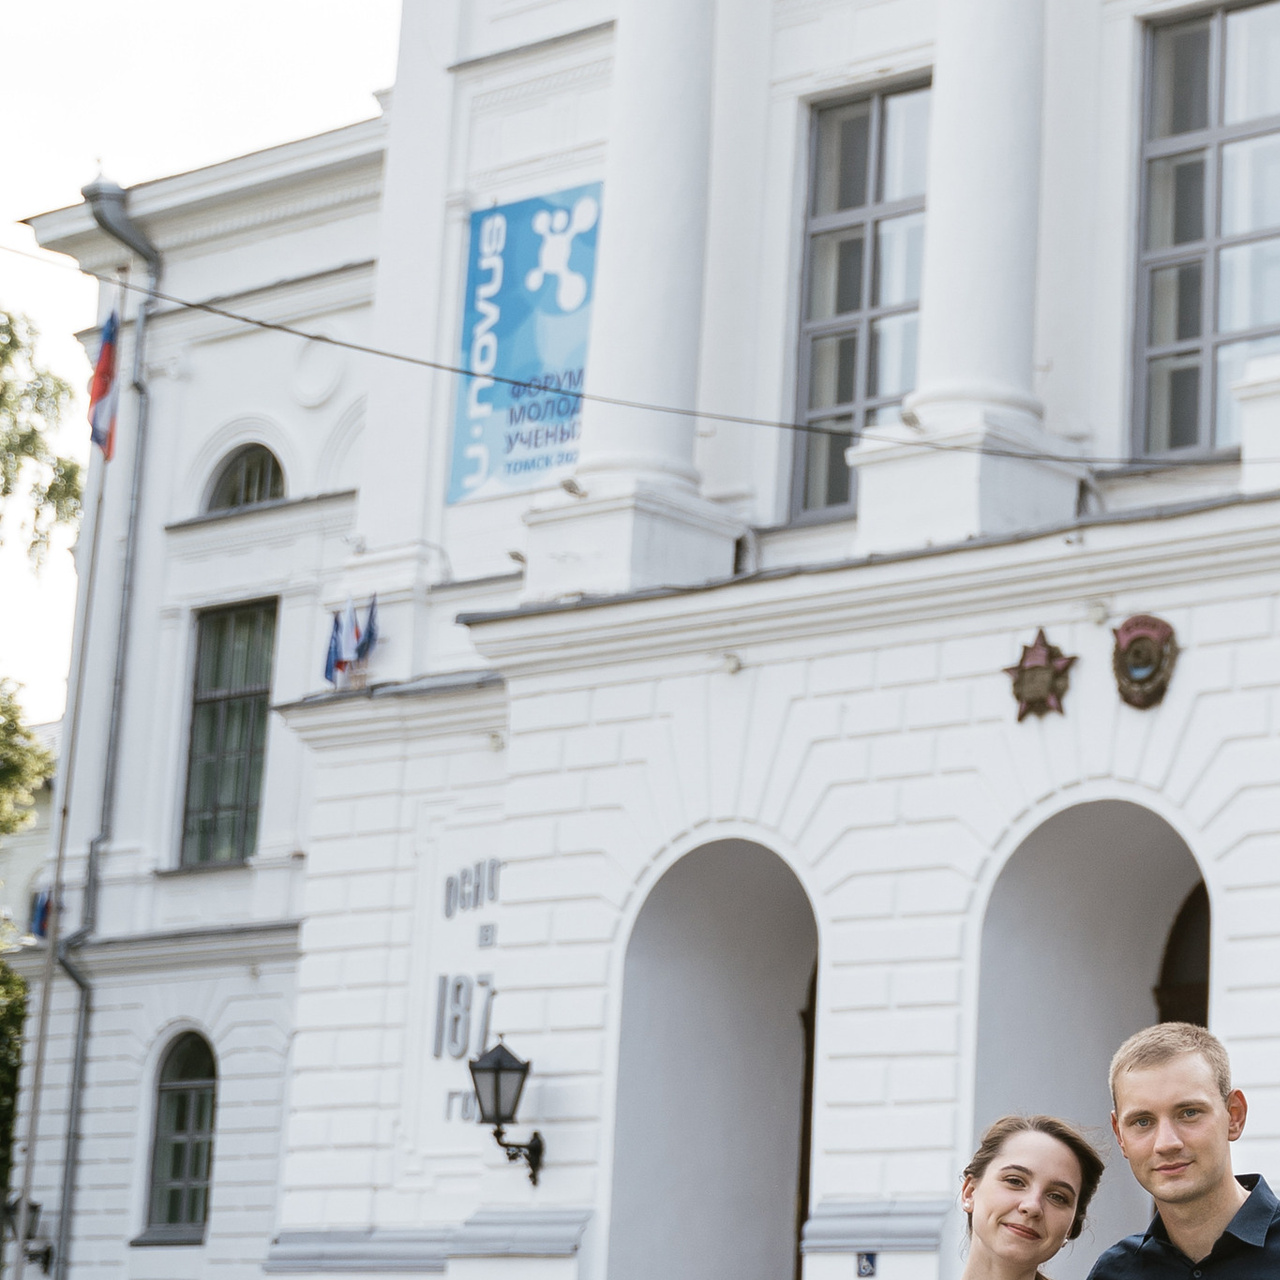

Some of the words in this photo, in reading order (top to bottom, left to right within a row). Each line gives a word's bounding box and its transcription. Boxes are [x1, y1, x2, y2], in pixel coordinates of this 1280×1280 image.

[510, 368, 584, 399] ФОРУМ
[509, 396, 583, 426] МОЛОД
[506, 457, 551, 475] ТОМСК
[434, 974, 495, 1059] 187
